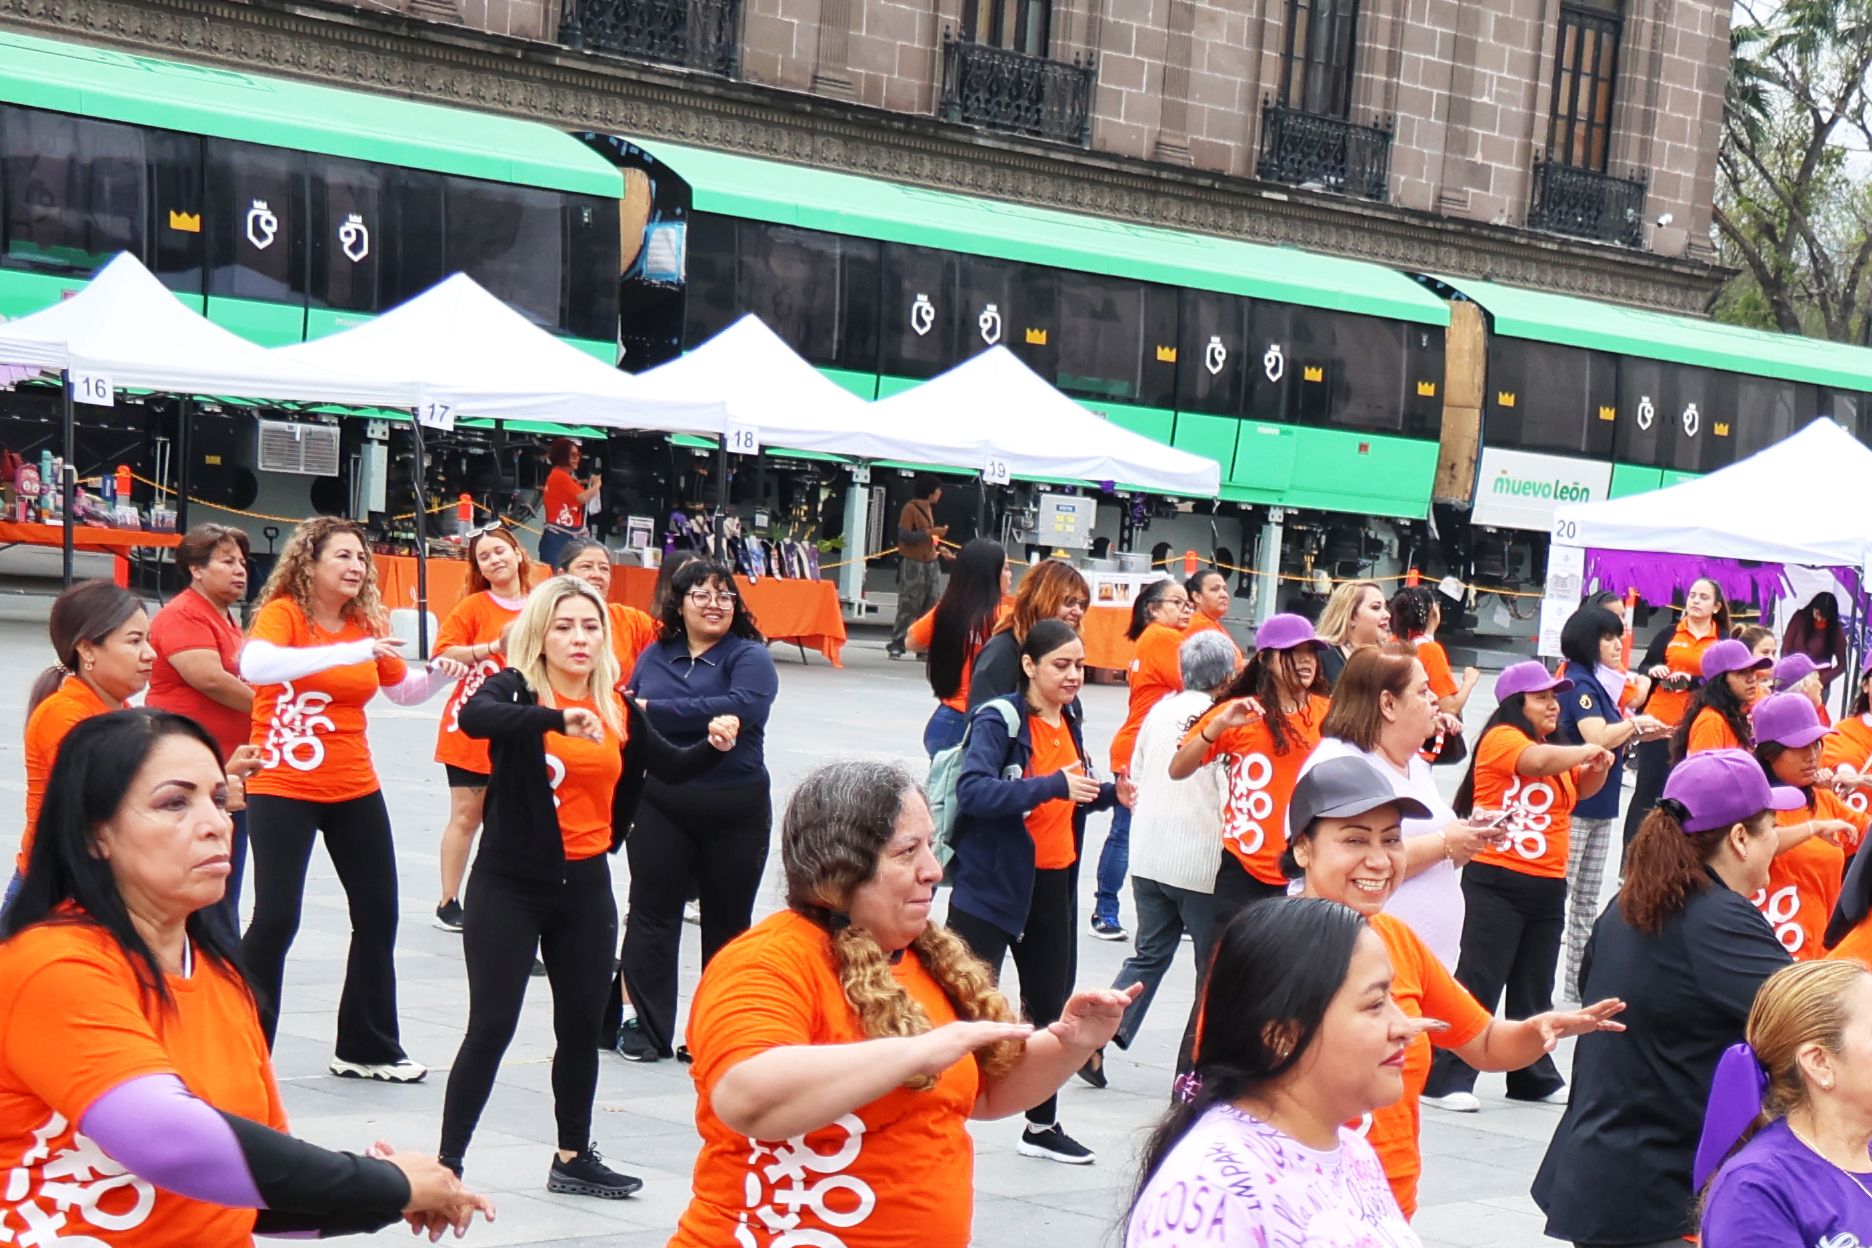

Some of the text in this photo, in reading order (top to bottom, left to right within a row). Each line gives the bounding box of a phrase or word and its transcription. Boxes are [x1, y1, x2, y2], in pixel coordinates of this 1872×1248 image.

[83, 377, 107, 398] 16
[428, 403, 450, 422] 17
[734, 431, 753, 448] 18
[989, 461, 1006, 478] 19
[1556, 519, 1577, 539] 20
